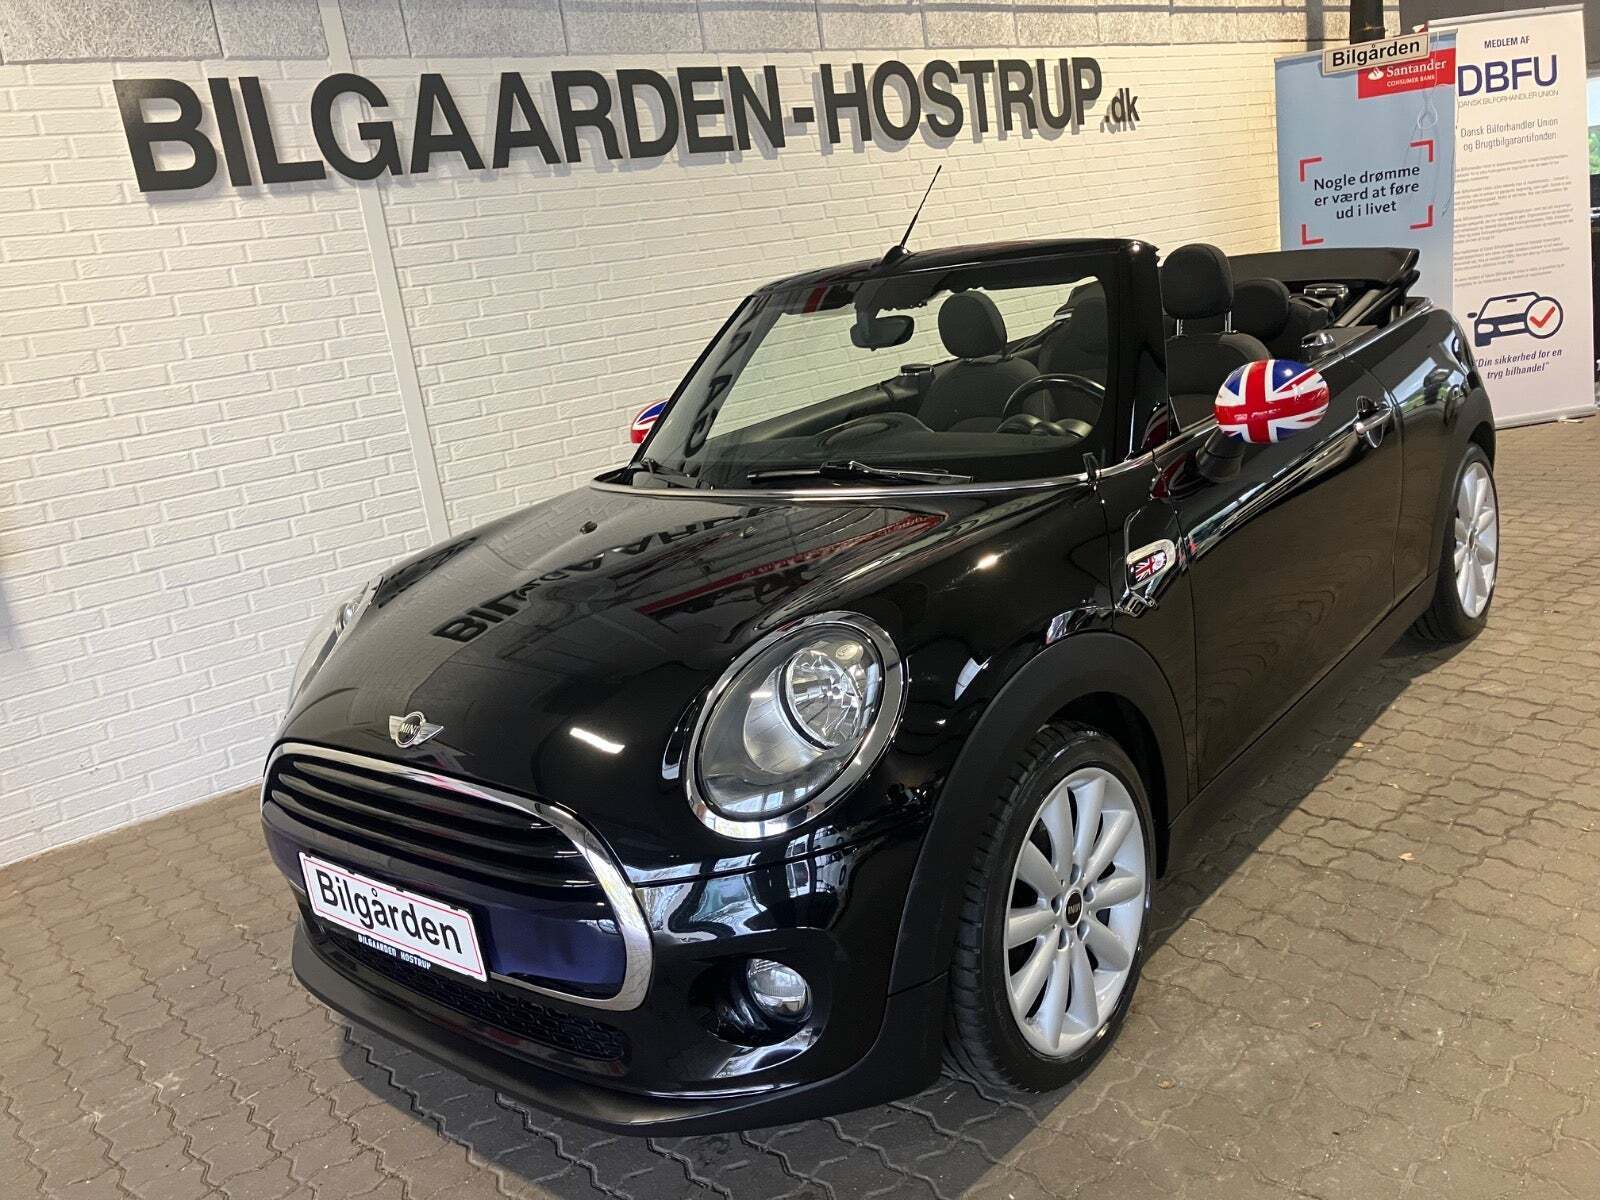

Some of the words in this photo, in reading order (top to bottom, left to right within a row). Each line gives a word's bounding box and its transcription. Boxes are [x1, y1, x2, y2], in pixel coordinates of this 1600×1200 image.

[1484, 37, 1518, 48] MEDLEM
[1520, 36, 1530, 44] AF
[1332, 41, 1420, 67] Bilgården
[1386, 59, 1447, 78] Santander
[1457, 54, 1558, 97] DBFU
[1386, 76, 1419, 87] CONSUMER
[1460, 126, 1484, 138] Dansk
[1486, 119, 1535, 135] Bilforhandler
[1537, 118, 1559, 128] Union
[1463, 142, 1473, 153] og
[1314, 174, 1356, 191] Nogle
[1359, 166, 1420, 184] drømme
[1314, 196, 1329, 207] er
[1332, 187, 1368, 204] værd
[1372, 186, 1386, 199] at
[1389, 182, 1420, 195] føre
[1336, 205, 1354, 220] ud
[1365, 201, 1397, 216] livet
[1494, 350, 1536, 365] sikkerhed
[1538, 350, 1550, 359] for
[1552, 349, 1562, 357] en
[1487, 371, 1504, 381] tryg
[315, 868, 463, 955] Bilgården
